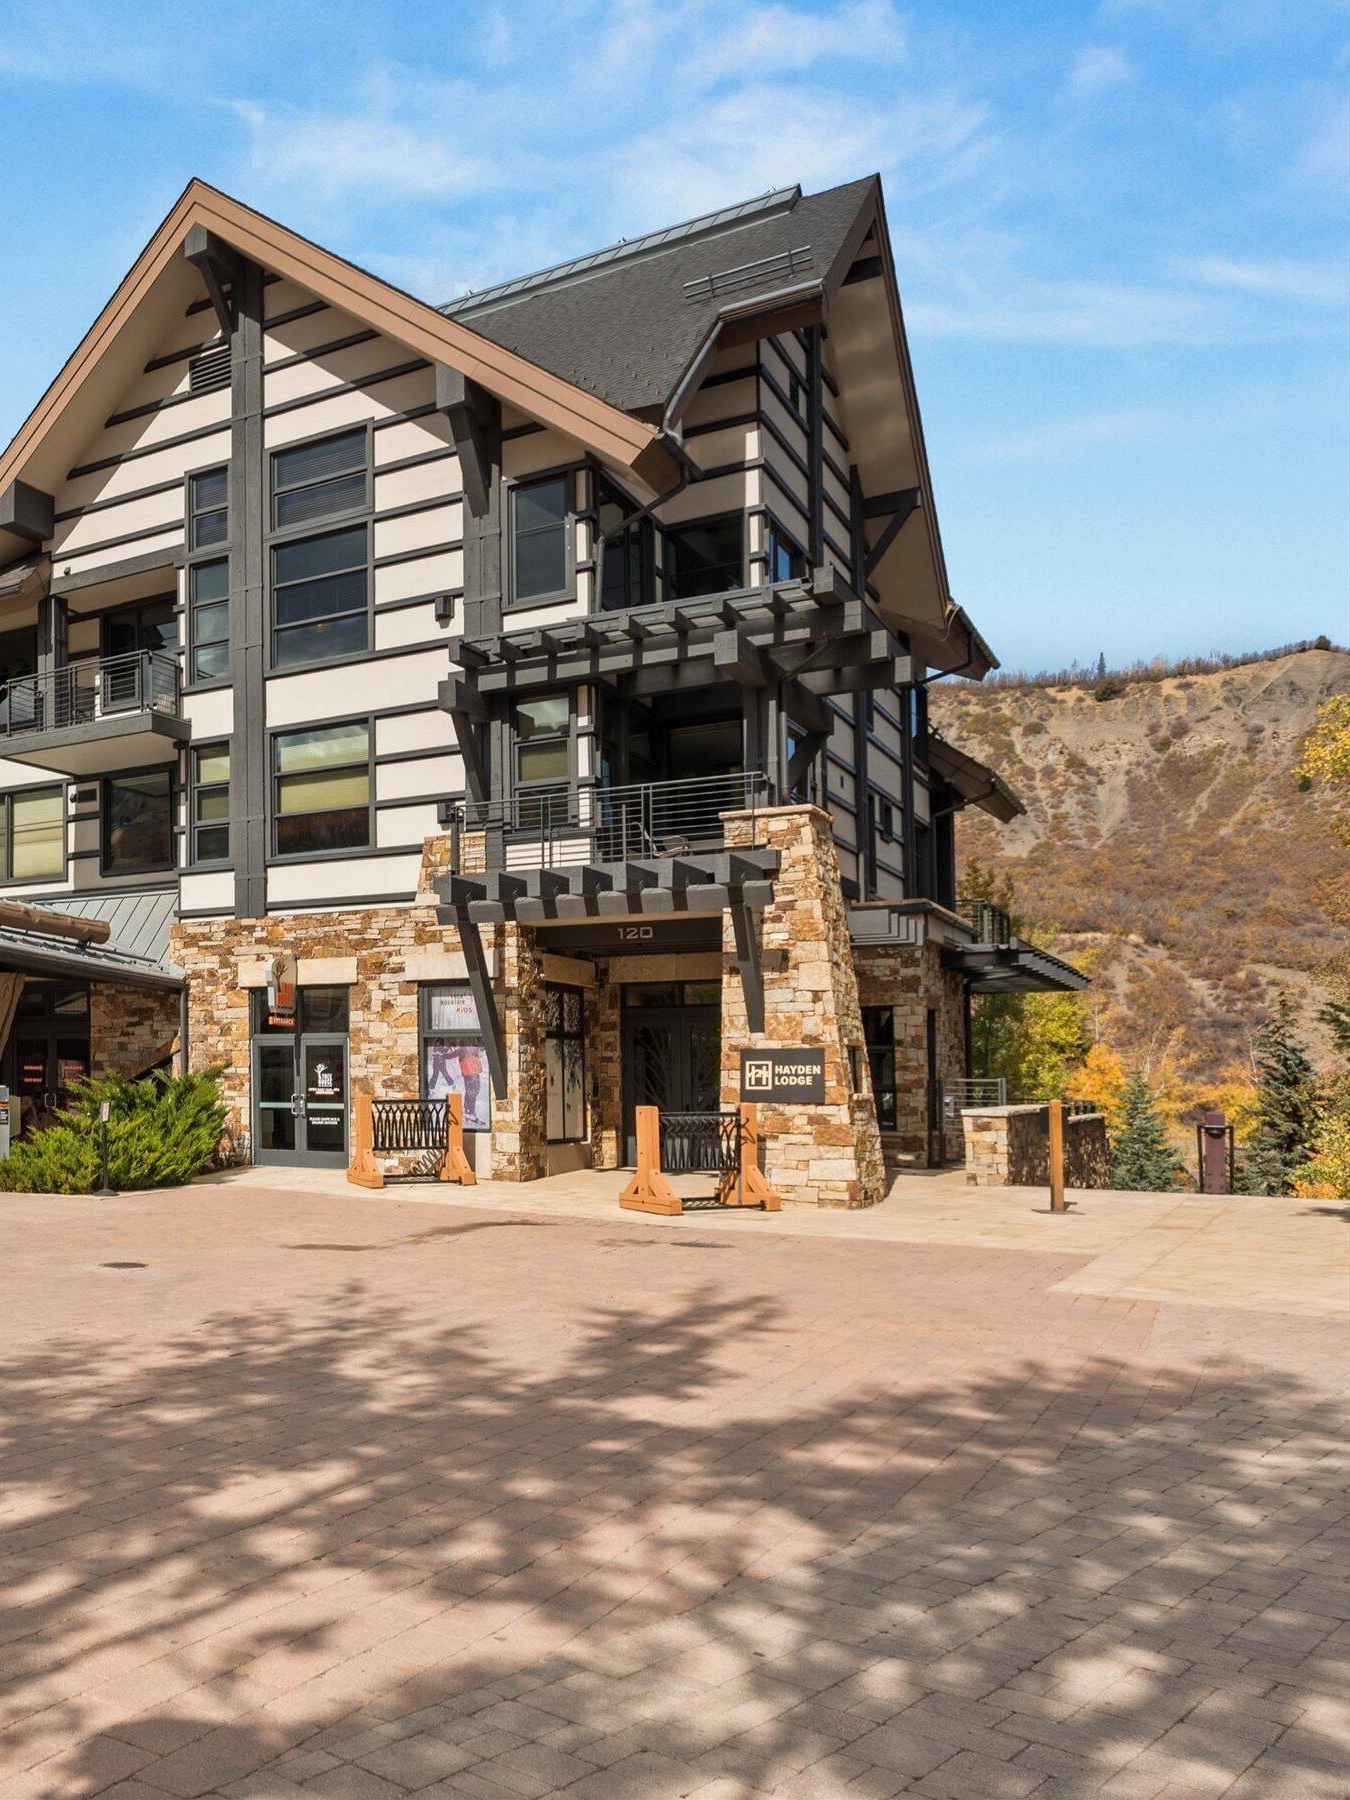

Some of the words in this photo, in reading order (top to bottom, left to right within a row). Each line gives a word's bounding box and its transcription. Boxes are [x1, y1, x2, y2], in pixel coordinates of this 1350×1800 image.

[618, 926, 653, 940] 120
[774, 1065, 822, 1075] HAYDEN
[774, 1076, 813, 1086] LODGE
